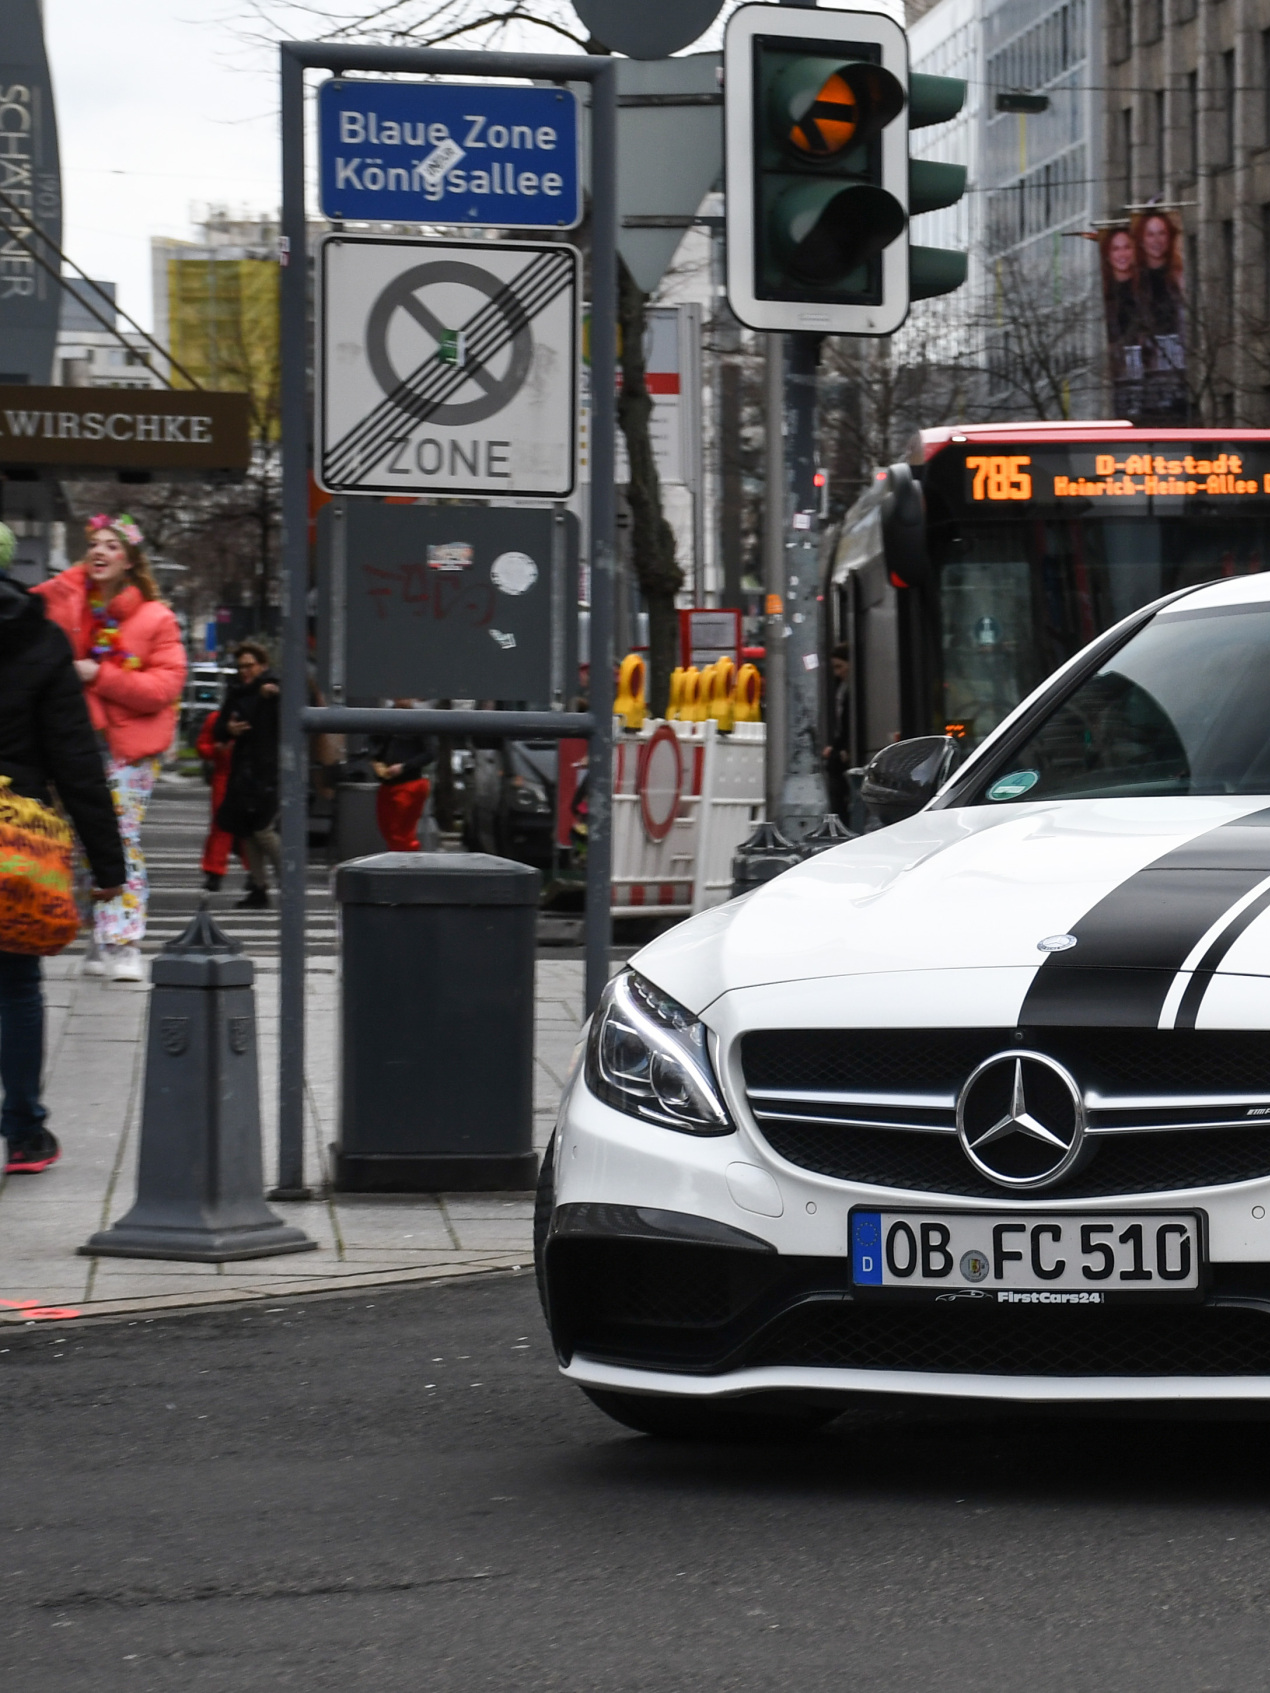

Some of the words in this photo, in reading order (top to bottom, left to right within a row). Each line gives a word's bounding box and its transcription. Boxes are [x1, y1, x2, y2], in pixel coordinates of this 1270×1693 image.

[339, 110, 450, 146] Blaue
[463, 115, 558, 150] Zone
[0, 84, 34, 300] SCHÄFFNER
[387, 436, 511, 478] ZONE
[965, 455, 1032, 500] 785
[1095, 454, 1243, 475] D-Altstadt
[1054, 474, 1258, 496] Heinrich-Heine-Allee
[862, 1257, 873, 1273] D
[885, 1220, 954, 1278] OB
[992, 1223, 1066, 1281] FC
[1080, 1223, 1192, 1281] 510
[997, 1291, 1101, 1304] FirstCars24
